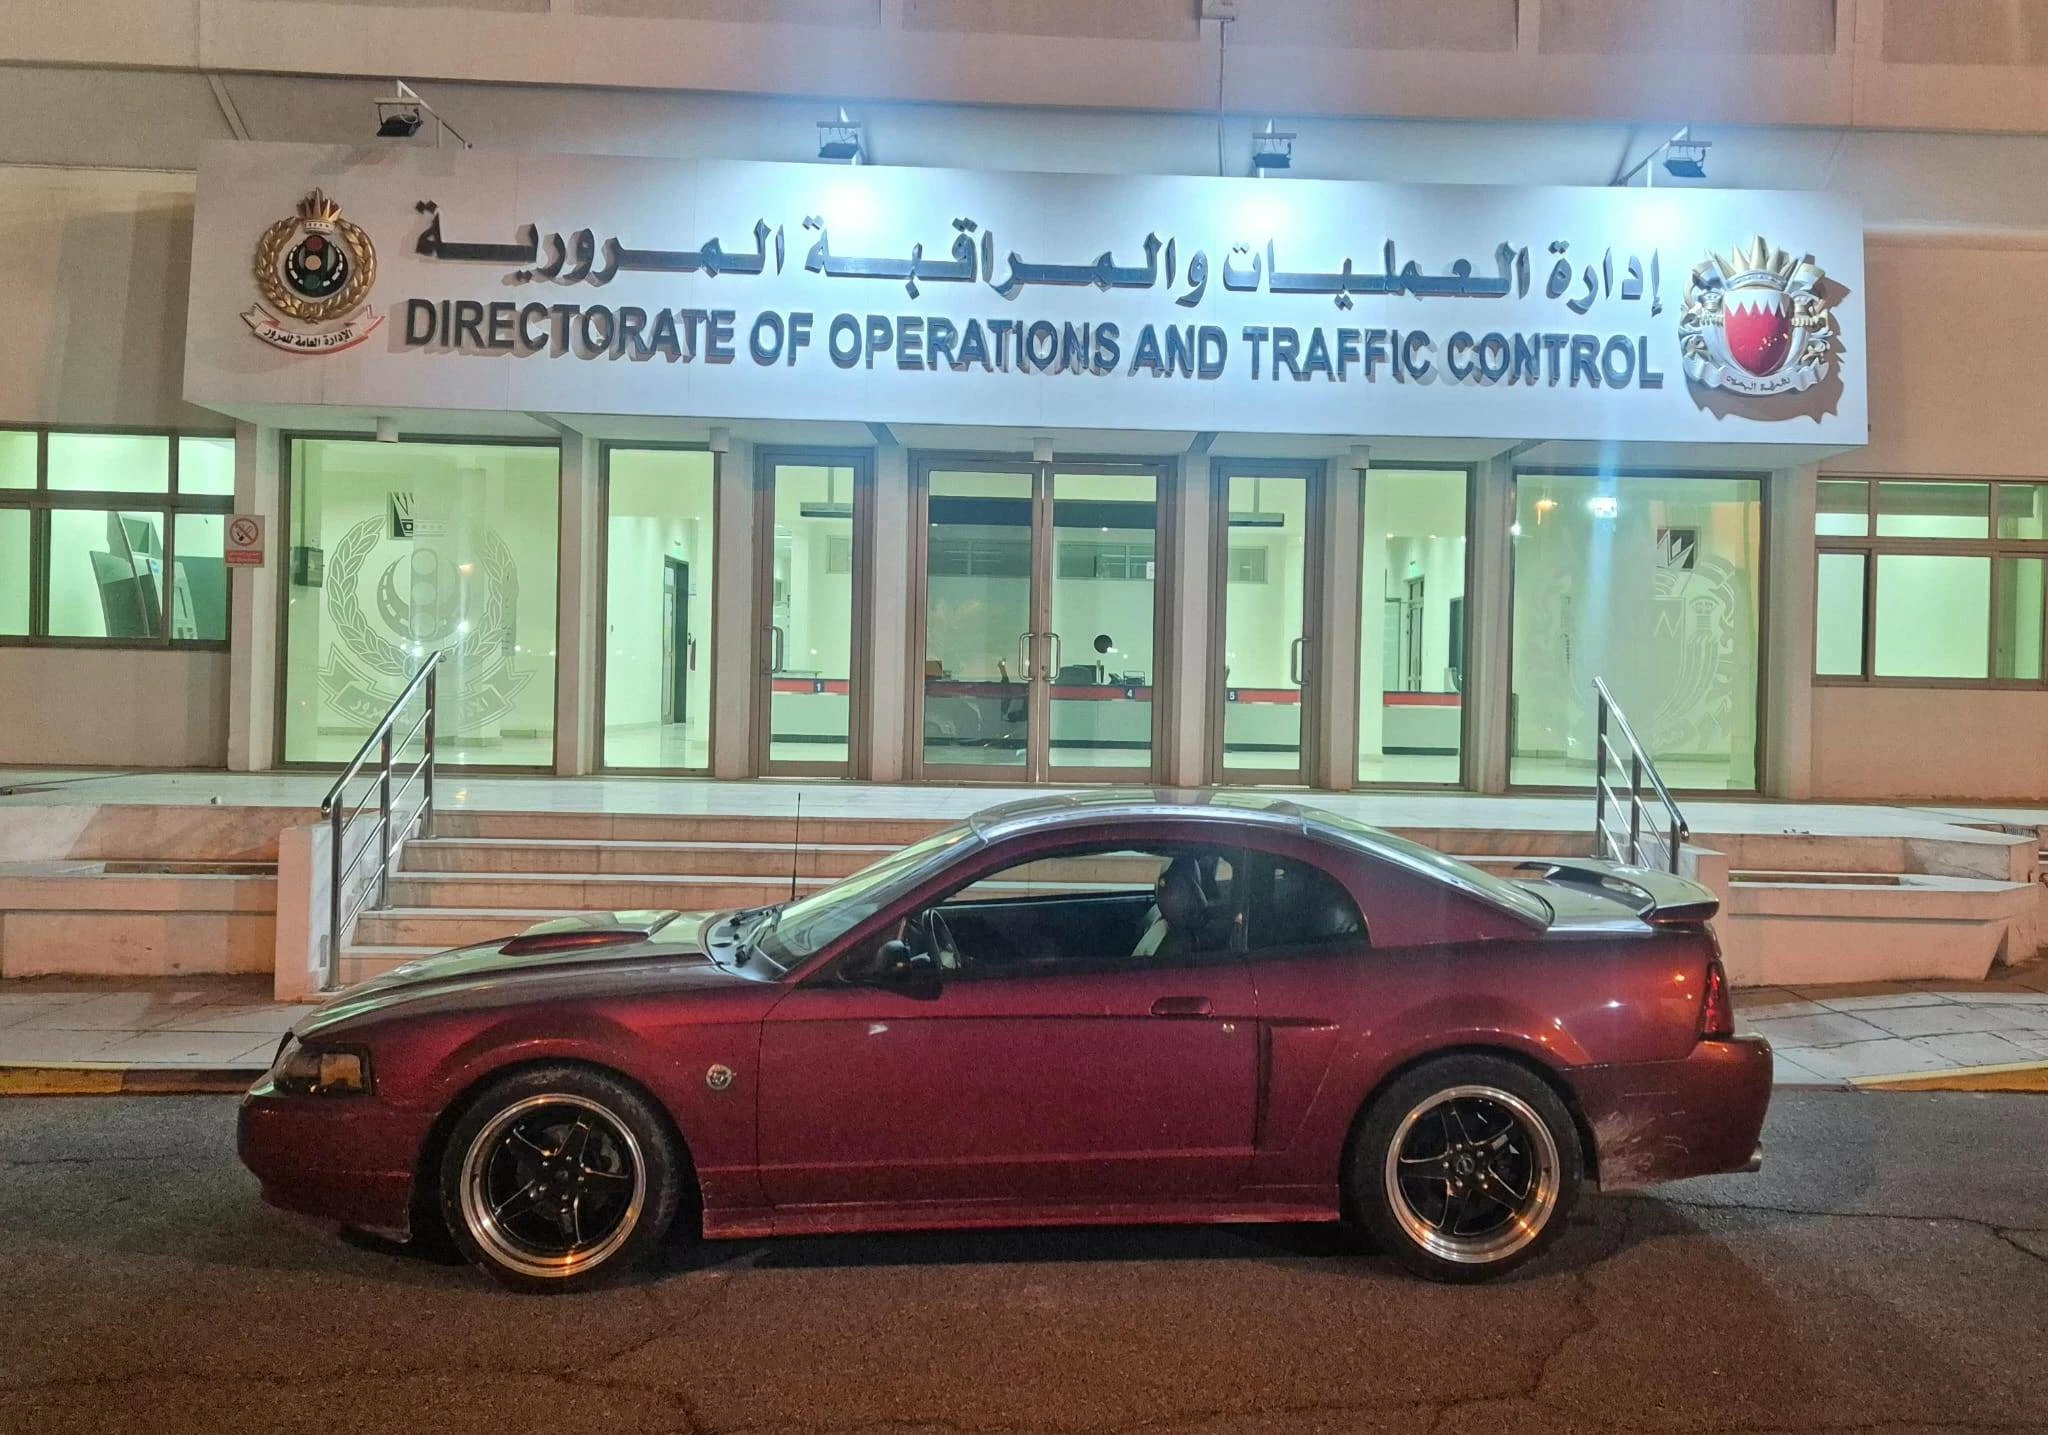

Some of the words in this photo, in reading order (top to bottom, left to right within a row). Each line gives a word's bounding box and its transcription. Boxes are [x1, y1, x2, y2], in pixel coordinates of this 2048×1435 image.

[413, 200, 784, 287] المرورية
[801, 215, 1209, 308] والمراقبة
[1223, 237, 1529, 311] العمليات
[1546, 239, 1664, 317] إدارة
[263, 327, 293, 344] للمرور
[296, 335, 321, 348] العامة
[324, 328, 353, 346] الإدارة
[405, 298, 738, 364] DIRECTORATE
[749, 310, 813, 366] OF
[828, 312, 1122, 375] OPERATIONS
[1128, 323, 1228, 380] AND
[1242, 325, 1432, 383] TRAFFIC
[1446, 330, 1664, 389] CONTROL
